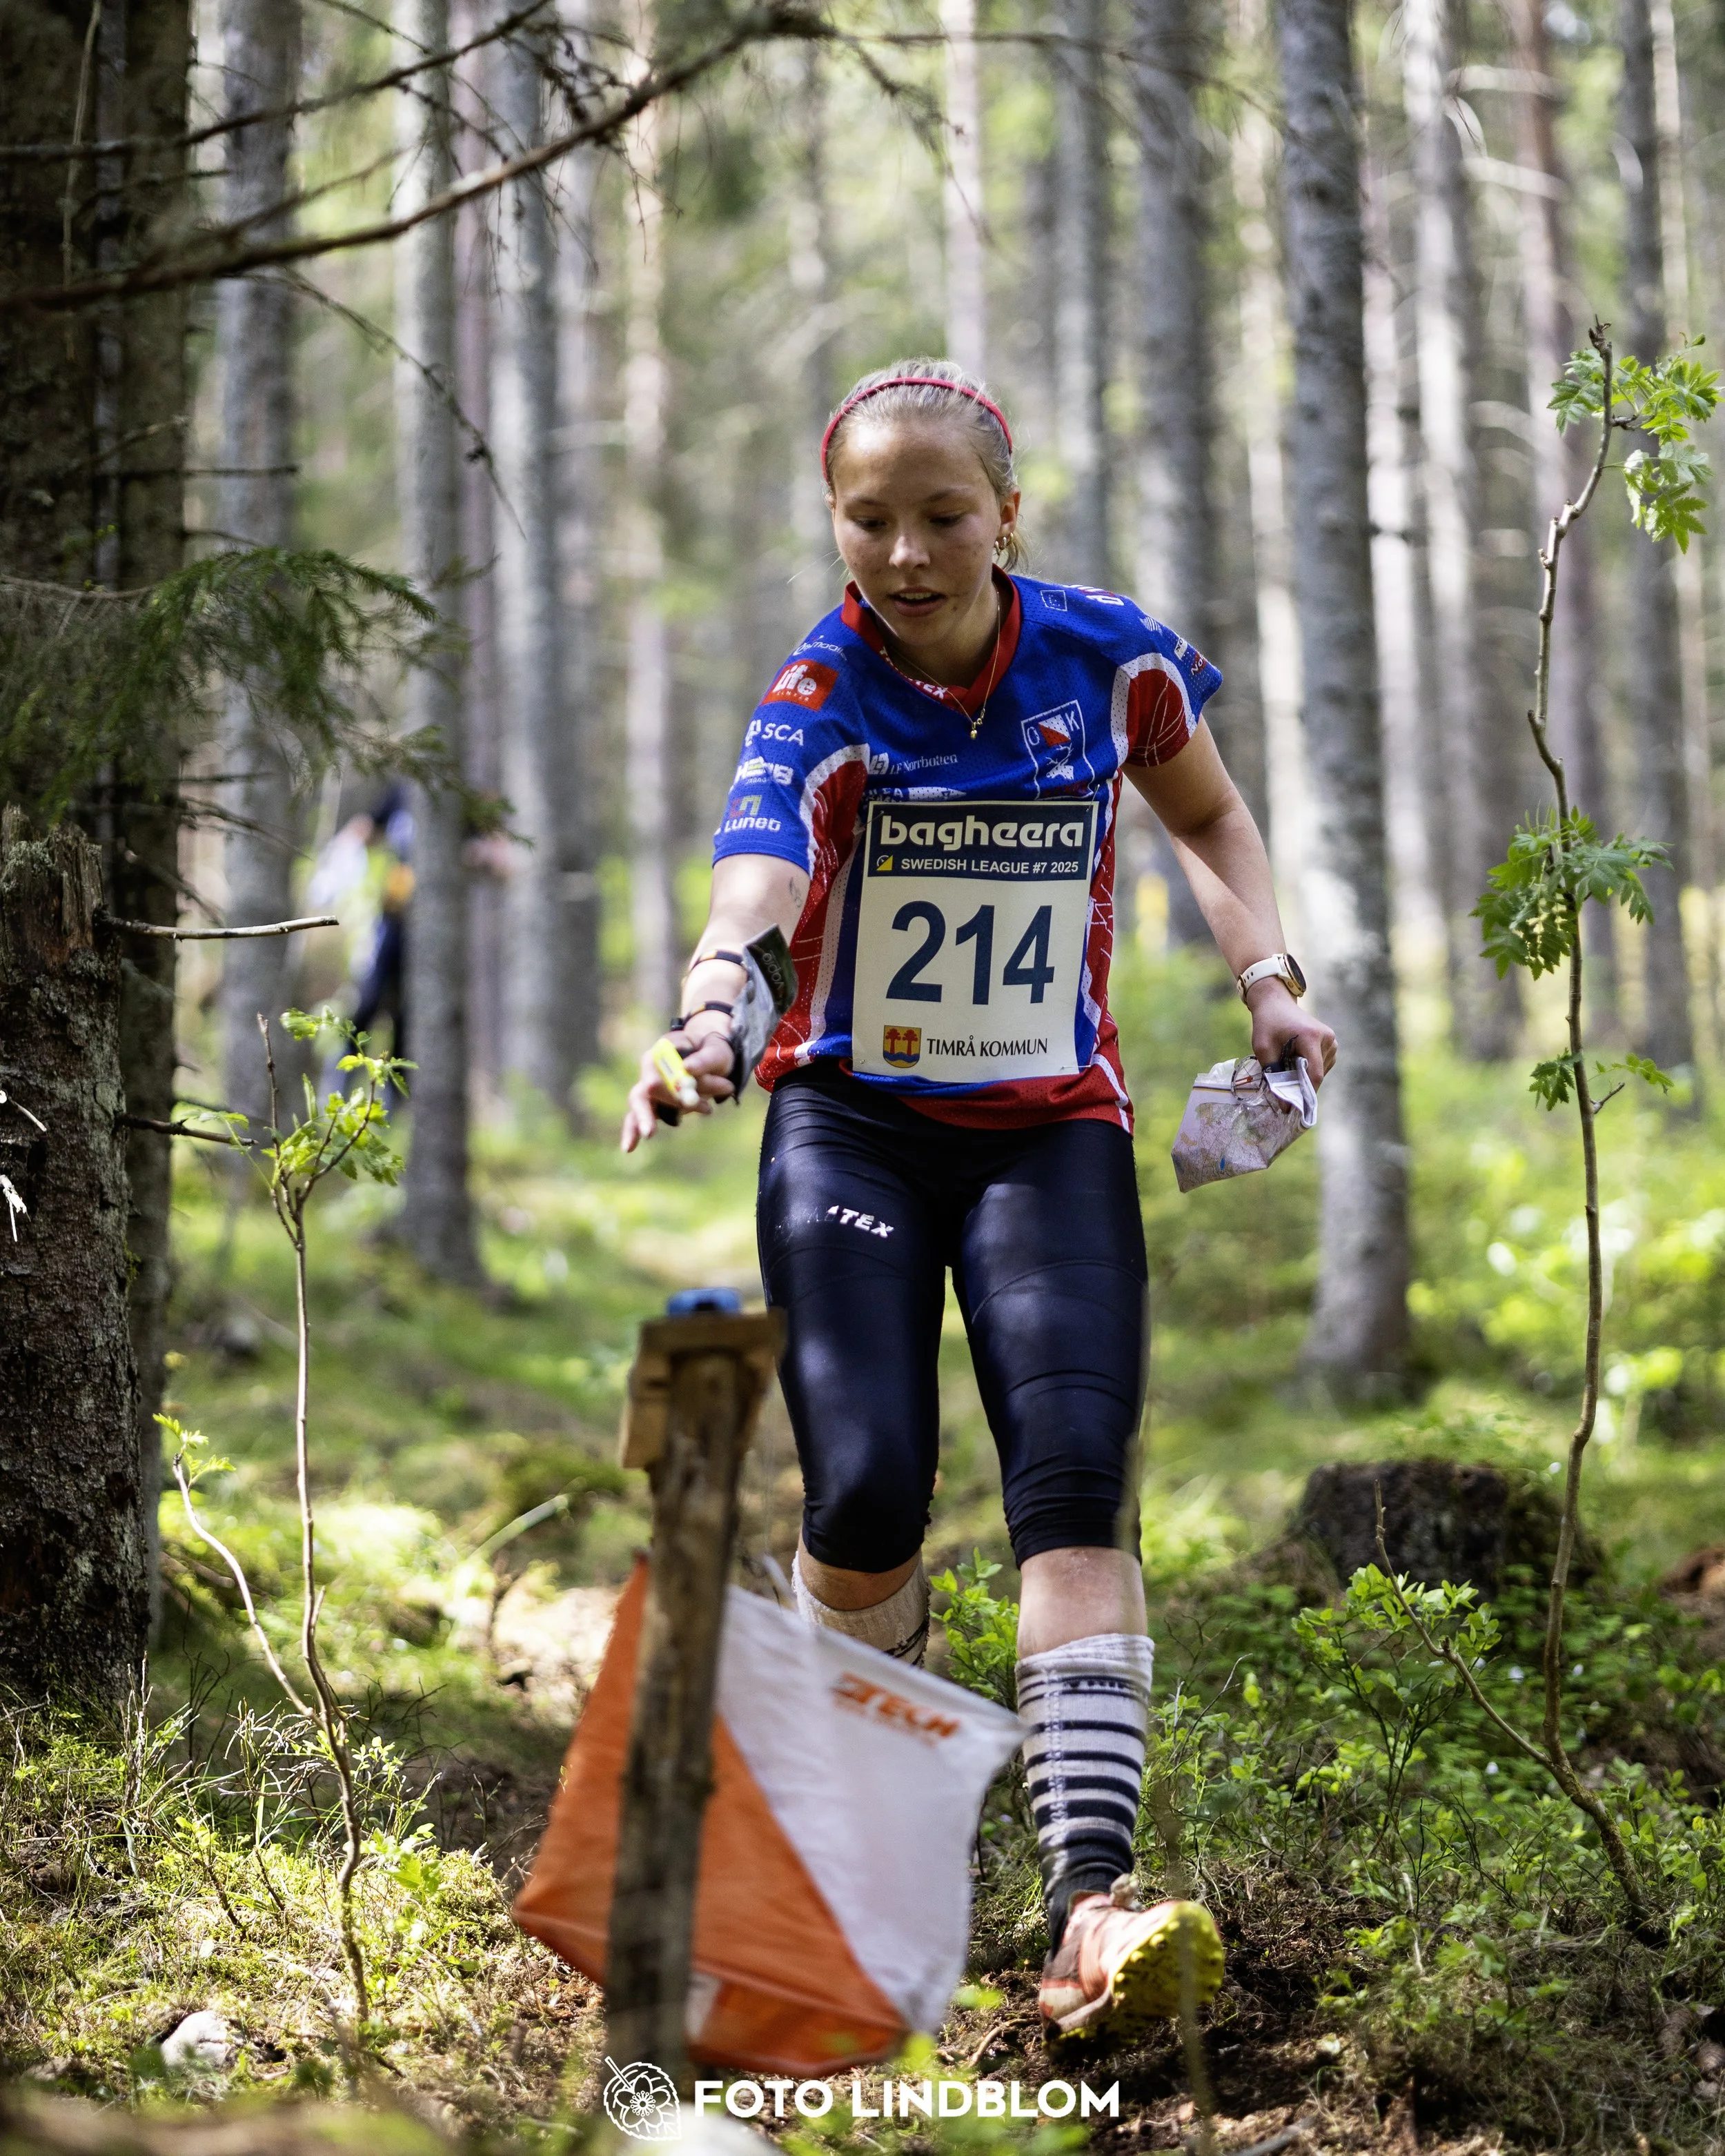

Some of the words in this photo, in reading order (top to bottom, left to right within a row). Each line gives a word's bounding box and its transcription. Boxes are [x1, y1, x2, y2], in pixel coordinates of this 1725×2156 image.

[761, 722, 804, 746] SCA
[880, 815, 1084, 851] bagheera
[900, 858, 967, 871] SWEDISH
[971, 859, 1029, 874] LEAGUE
[1032, 861, 1047, 874] #7
[1050, 860, 1079, 873] 2025
[885, 900, 1055, 1005] 214
[926, 1035, 976, 1057] TIMRÅ
[980, 1038, 1048, 1057] KOMMUN
